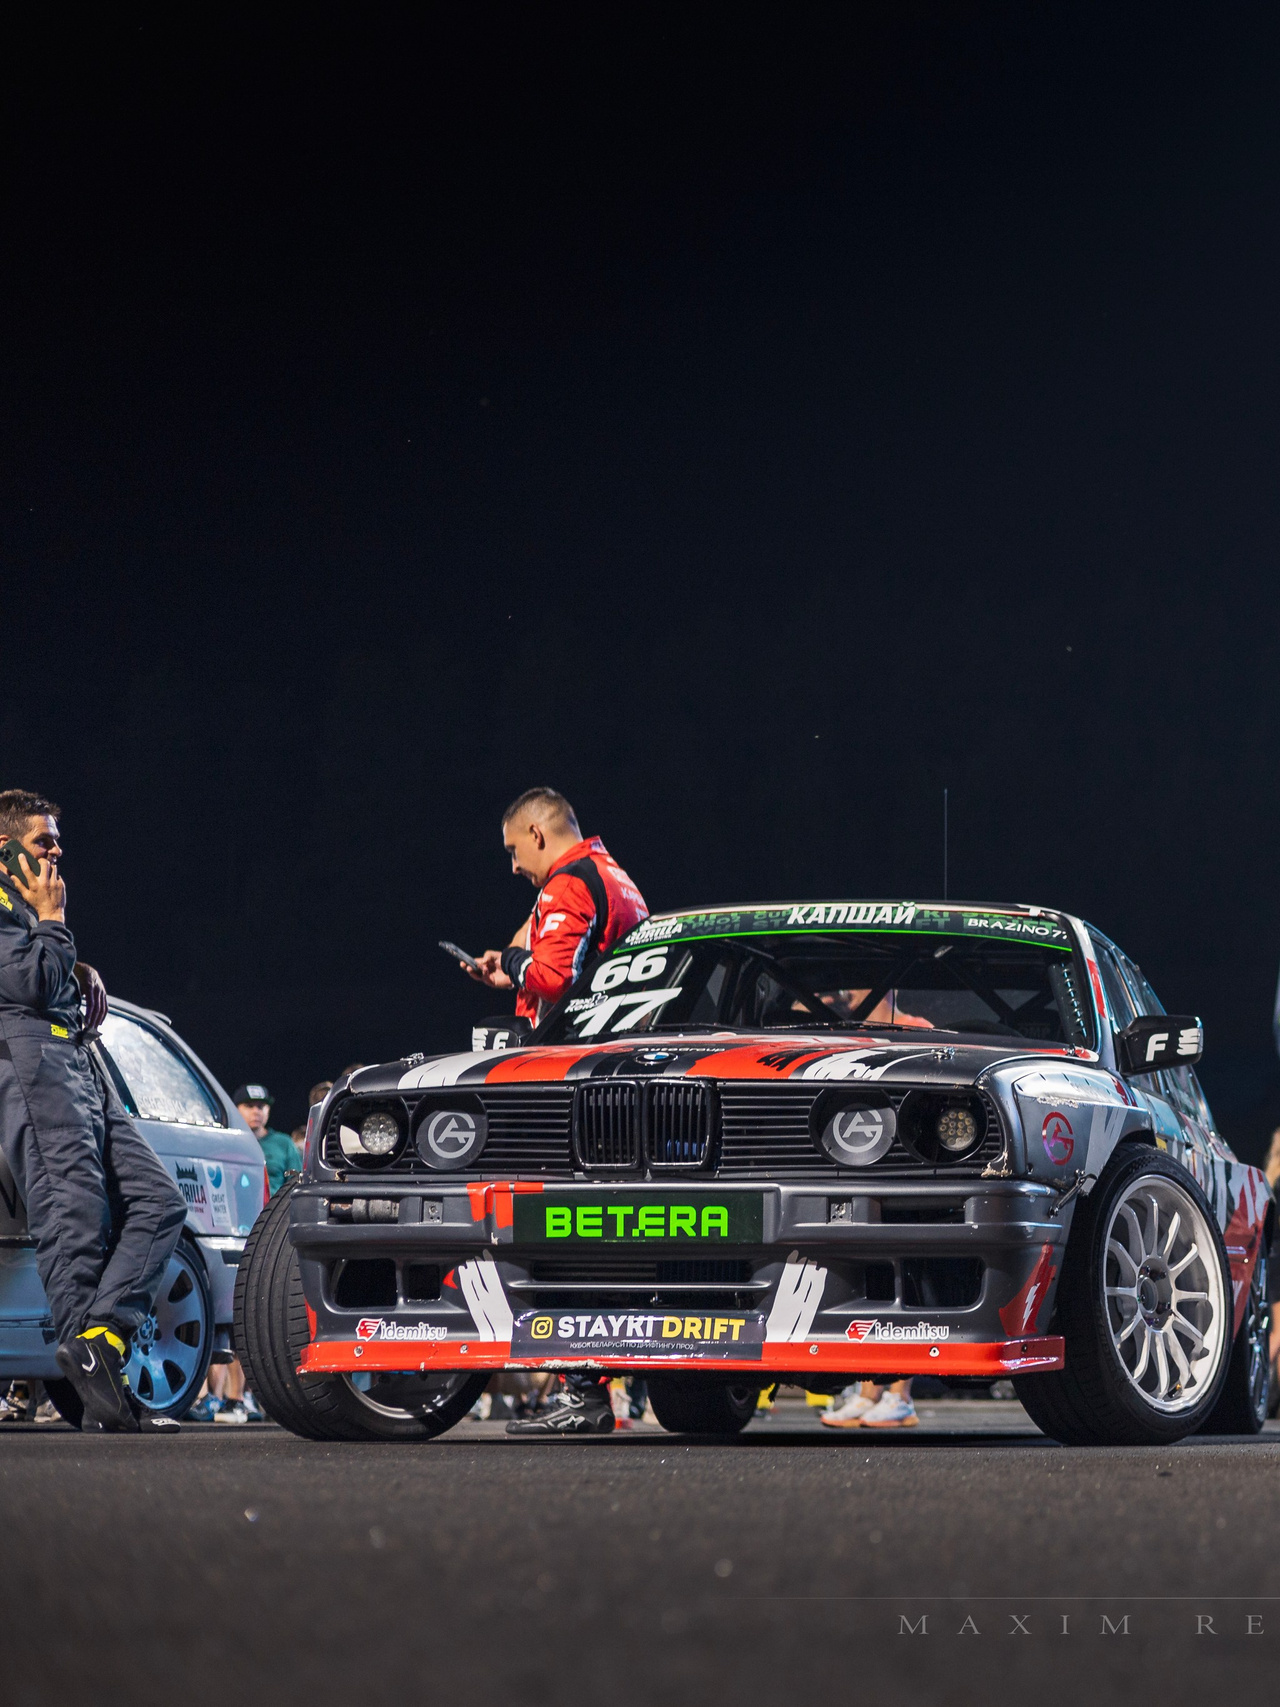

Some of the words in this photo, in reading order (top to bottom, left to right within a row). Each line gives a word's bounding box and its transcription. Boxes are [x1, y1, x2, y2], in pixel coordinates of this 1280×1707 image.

[786, 901, 916, 925] КАПШАЙ
[591, 946, 669, 993] 66
[573, 987, 683, 1038] 17
[379, 1320, 448, 1341] idemitsu
[557, 1315, 654, 1338] STAYKI
[661, 1315, 746, 1341] DRIFT
[874, 1321, 950, 1341] idemitsu
